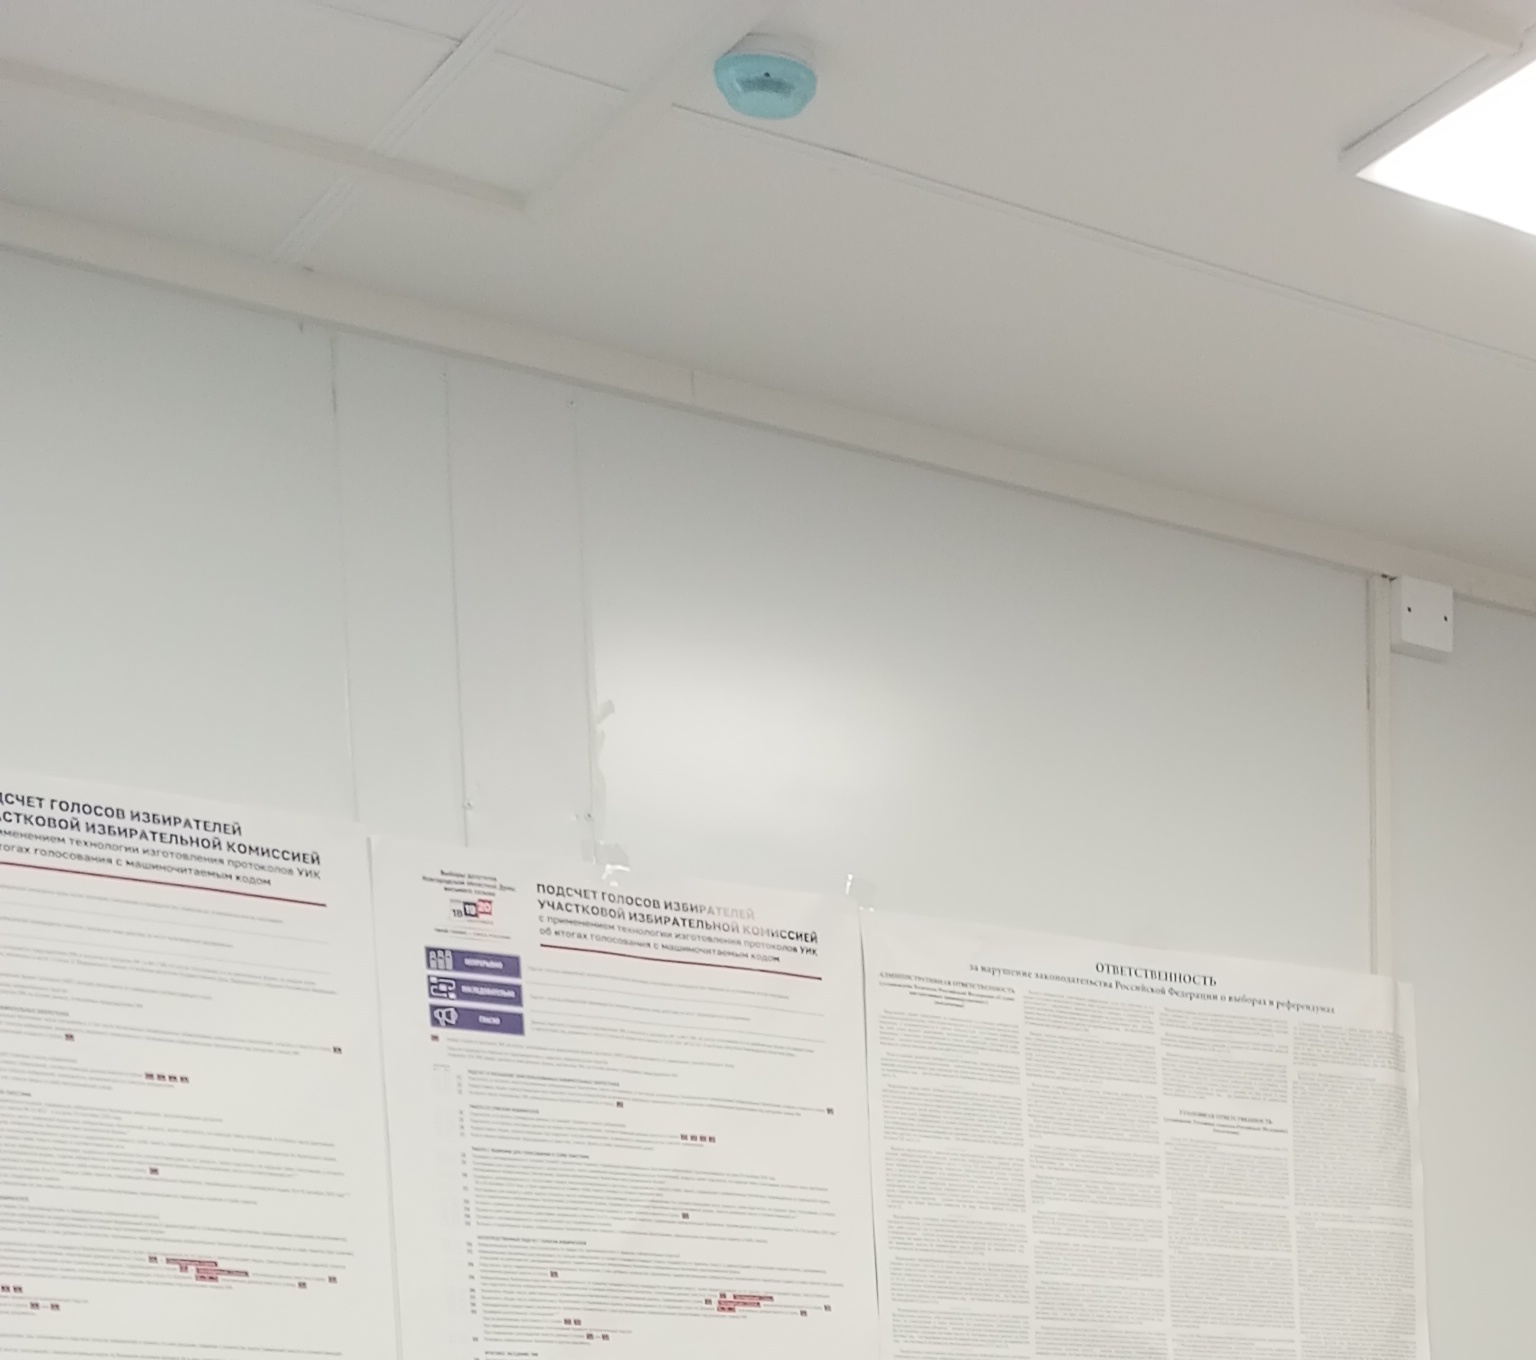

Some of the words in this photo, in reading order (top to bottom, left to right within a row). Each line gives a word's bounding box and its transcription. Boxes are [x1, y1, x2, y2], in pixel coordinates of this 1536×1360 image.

[0, 791, 46, 808] СЧЕТ
[50, 799, 126, 820] ГОЛОСОВ
[130, 809, 243, 836] ИЗБИРАТЕЛЕЙ
[0, 811, 81, 832] СТКОВОЙ
[85, 821, 223, 851] ИЗБИРАТЕЛЬНОЙ
[226, 841, 321, 866] КОМИССИЕЙ
[69, 837, 140, 854] технологии
[143, 848, 225, 866] изготовления
[227, 858, 294, 876] протоколов
[296, 867, 321, 881] УИК
[34, 846, 113, 865] голосования
[115, 858, 123, 867] с
[125, 859, 233, 881] машиночитаемым
[235, 874, 272, 887] кодом
[536, 883, 598, 900] ПОДСЧЕТ
[601, 891, 661, 910] ГОЛОСОВ
[663, 899, 756, 921] ИЗБИРАТЕЛЕЙ
[537, 899, 626, 921] УЧАСТКОВОЙ
[628, 911, 740, 934] ИЗБИРАТЕЛЬНОЙ
[742, 924, 819, 944] КОМИССИЕЙ
[539, 927, 552, 937] об
[554, 930, 588, 941] итогах
[590, 933, 651, 949] голосования
[661, 944, 749, 959] машиночитаемым
[750, 953, 780, 963] кодом
[547, 916, 615, 931] применением
[617, 925, 672, 939] технологии
[674, 932, 742, 947] изготовления
[743, 940, 798, 954] протоколов
[799, 945, 819, 957] УИК
[968, 964, 979, 972] за
[980, 965, 1033, 979] нарушение
[1034, 971, 1113, 989] законодательства
[1115, 980, 1166, 996] Российской
[1168, 987, 1218, 1003] Федерации
[1228, 994, 1267, 1008] выборах
[1276, 999, 1336, 1015] референдумах
[1095, 962, 1217, 987] ОТВЕТСТВЕННОСТЬ
